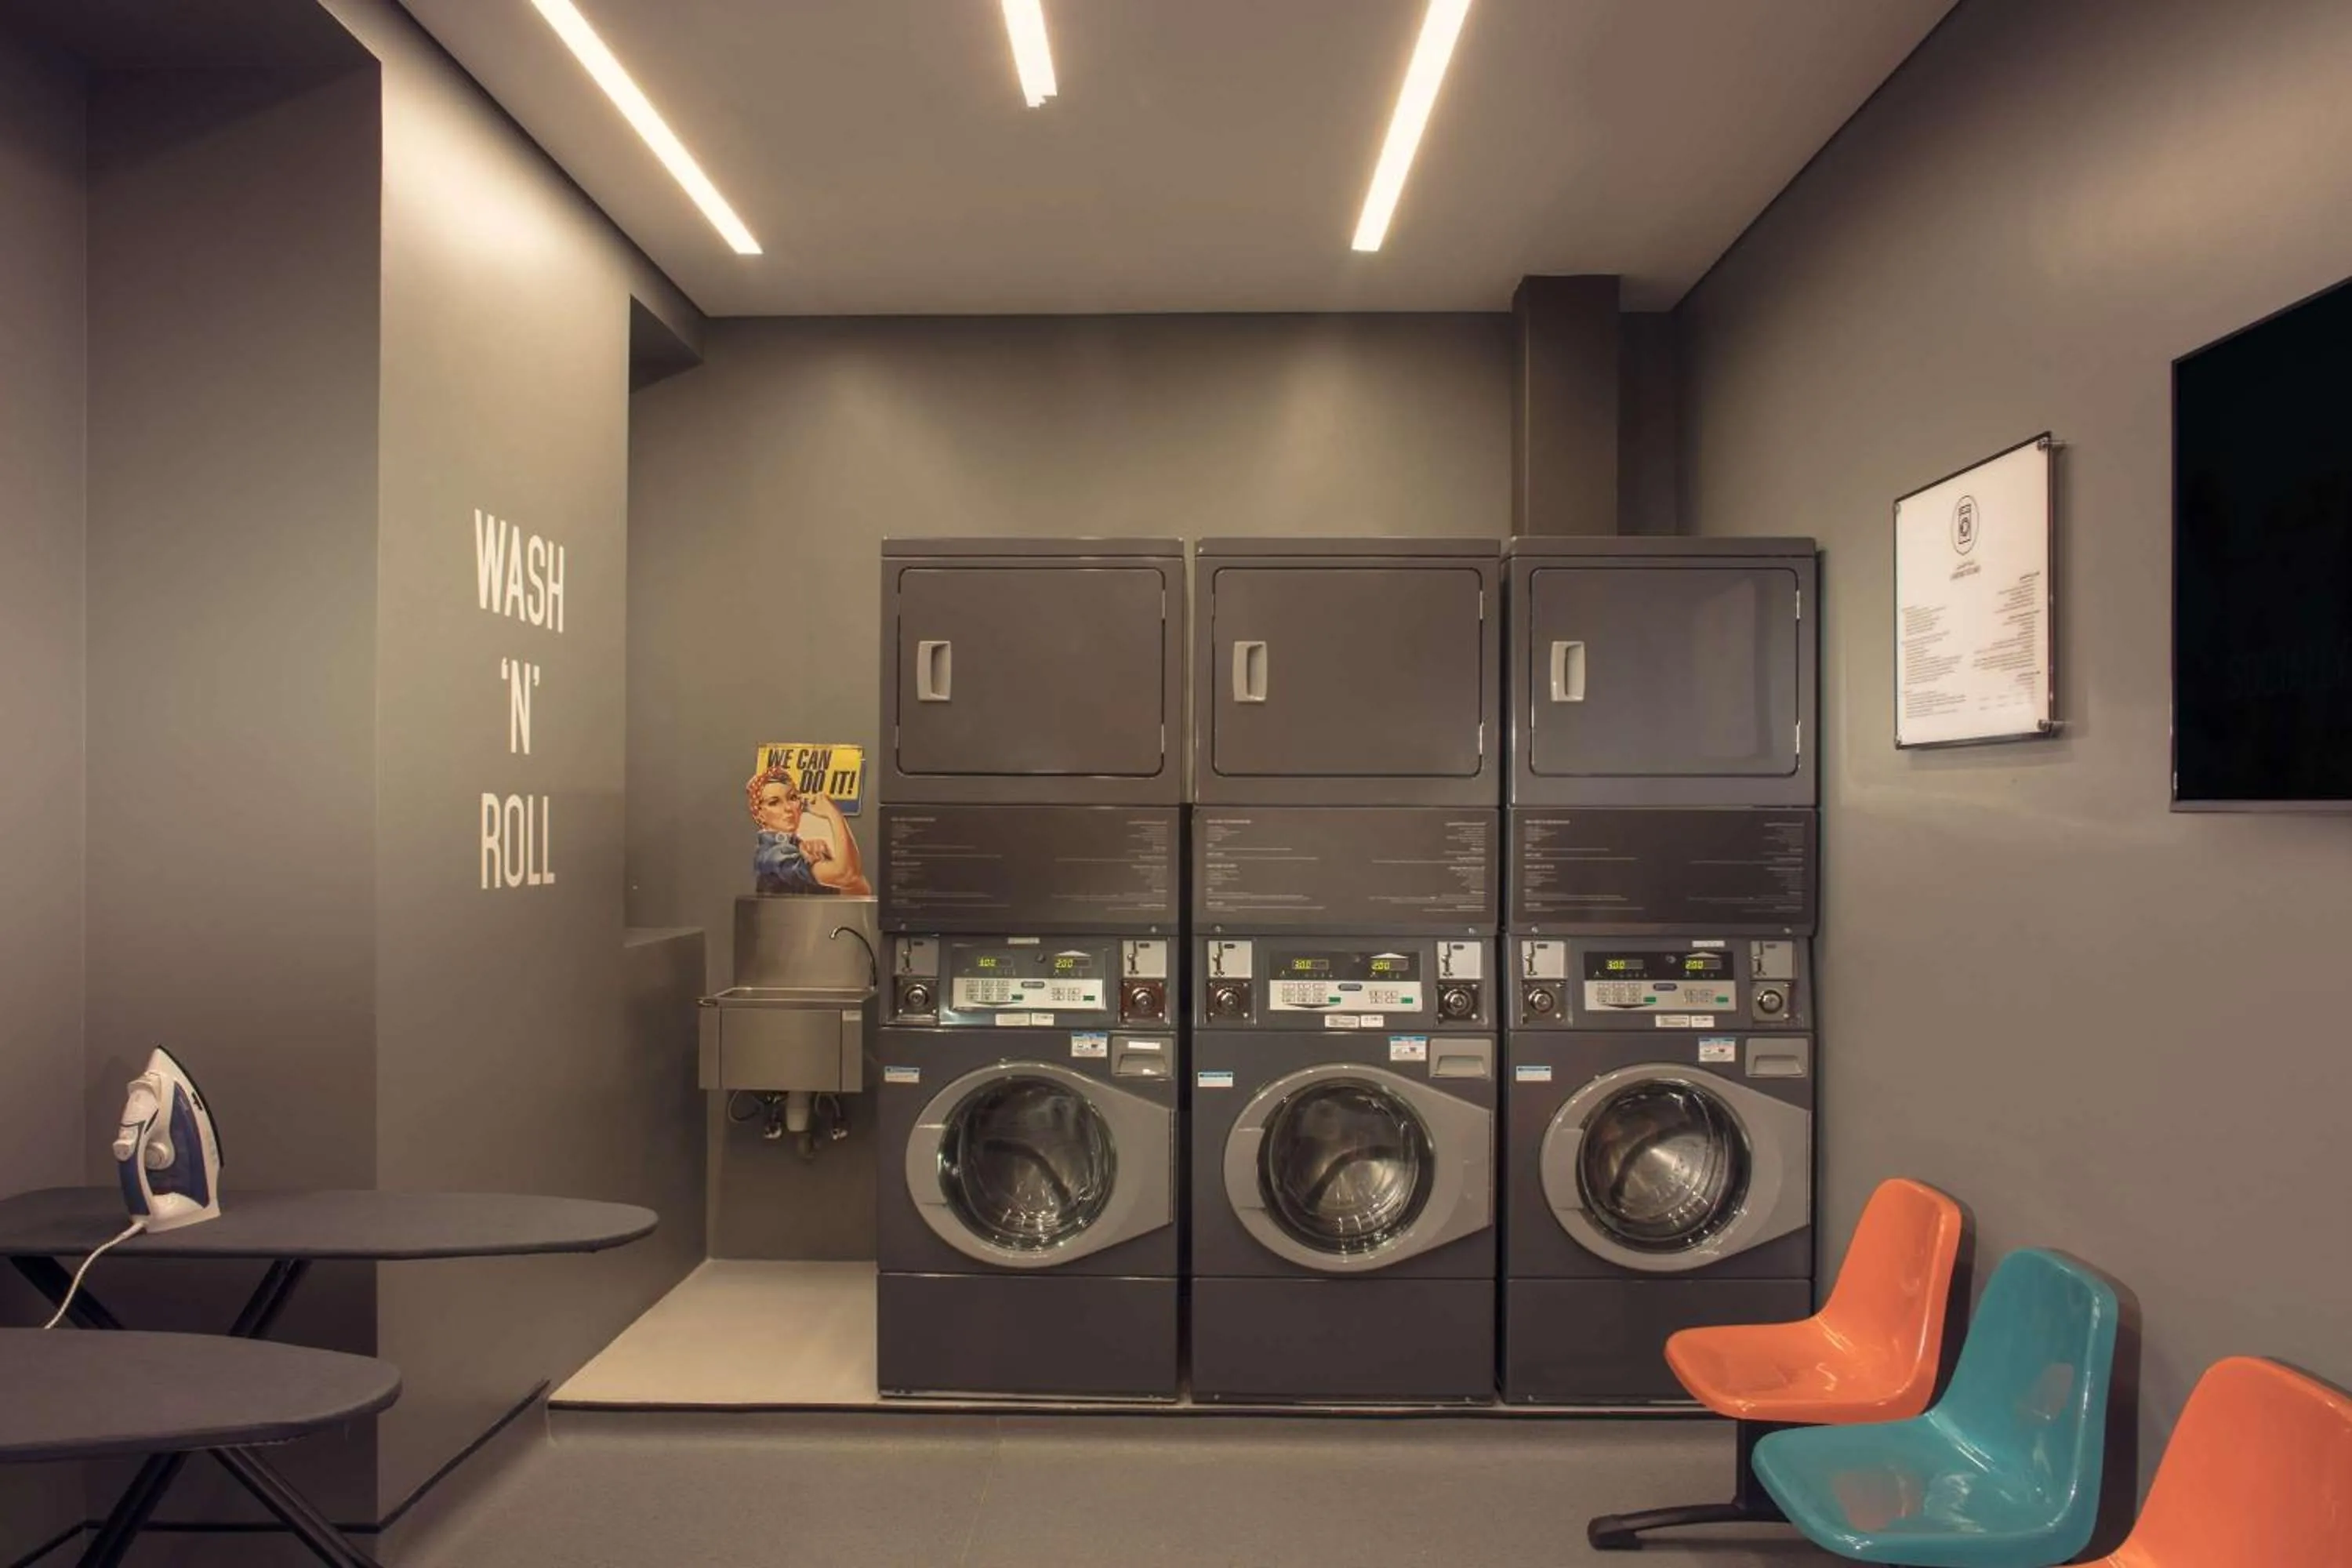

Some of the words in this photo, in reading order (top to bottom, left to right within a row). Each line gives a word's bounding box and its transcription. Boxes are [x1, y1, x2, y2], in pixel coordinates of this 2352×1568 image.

[474, 508, 564, 633] WASH
[767, 749, 793, 769] WE
[797, 749, 833, 770] CAN
[799, 771, 826, 794] DO
[829, 771, 857, 796] IT!
[481, 792, 556, 890] ROLL
